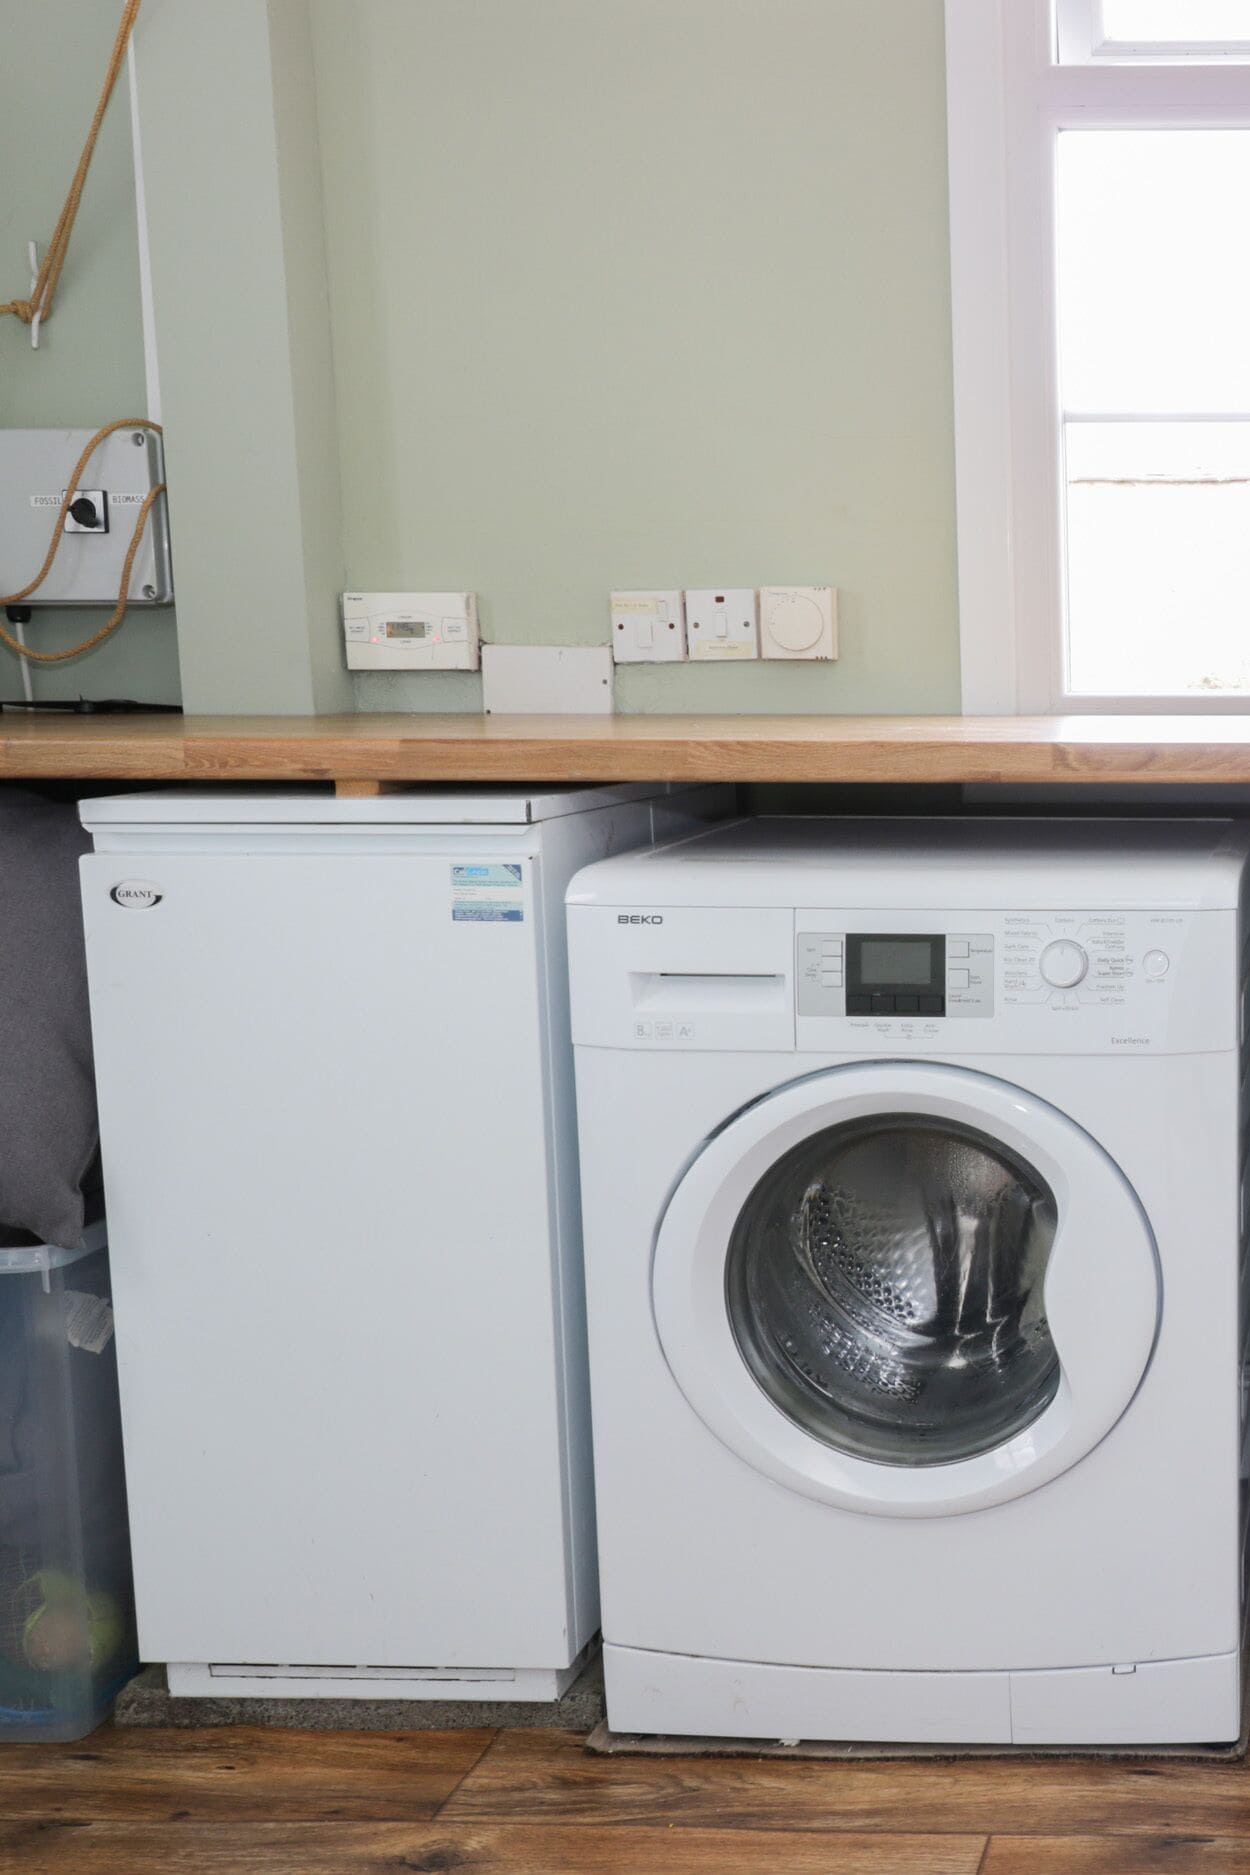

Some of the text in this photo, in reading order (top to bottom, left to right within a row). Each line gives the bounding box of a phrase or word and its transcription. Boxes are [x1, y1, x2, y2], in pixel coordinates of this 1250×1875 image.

[34, 496, 62, 506] FOSSIL
[112, 495, 145, 505] BIOMASS
[117, 890, 152, 898] GRANT
[617, 915, 663, 925] BEKO
[1110, 1037, 1150, 1045] Excellence
